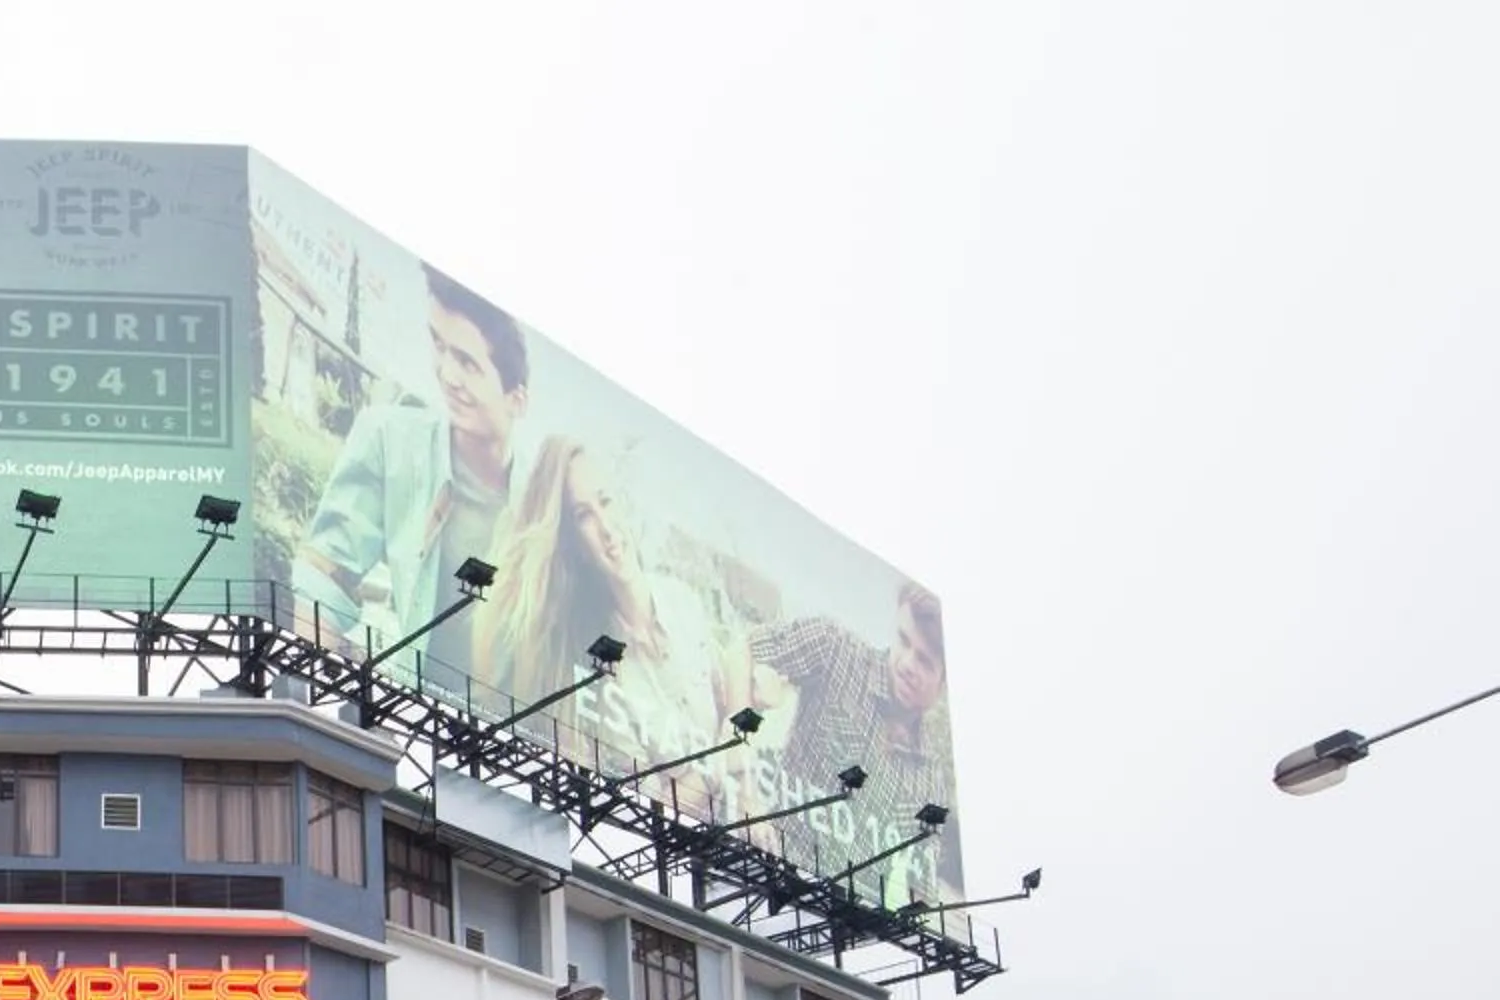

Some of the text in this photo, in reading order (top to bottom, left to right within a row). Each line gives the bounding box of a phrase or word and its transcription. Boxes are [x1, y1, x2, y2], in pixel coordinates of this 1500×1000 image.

[27, 185, 162, 239] JEEP
[8, 308, 203, 344] SPIRIT
[5, 362, 171, 397] 1941
[60, 411, 179, 431] SOULS
